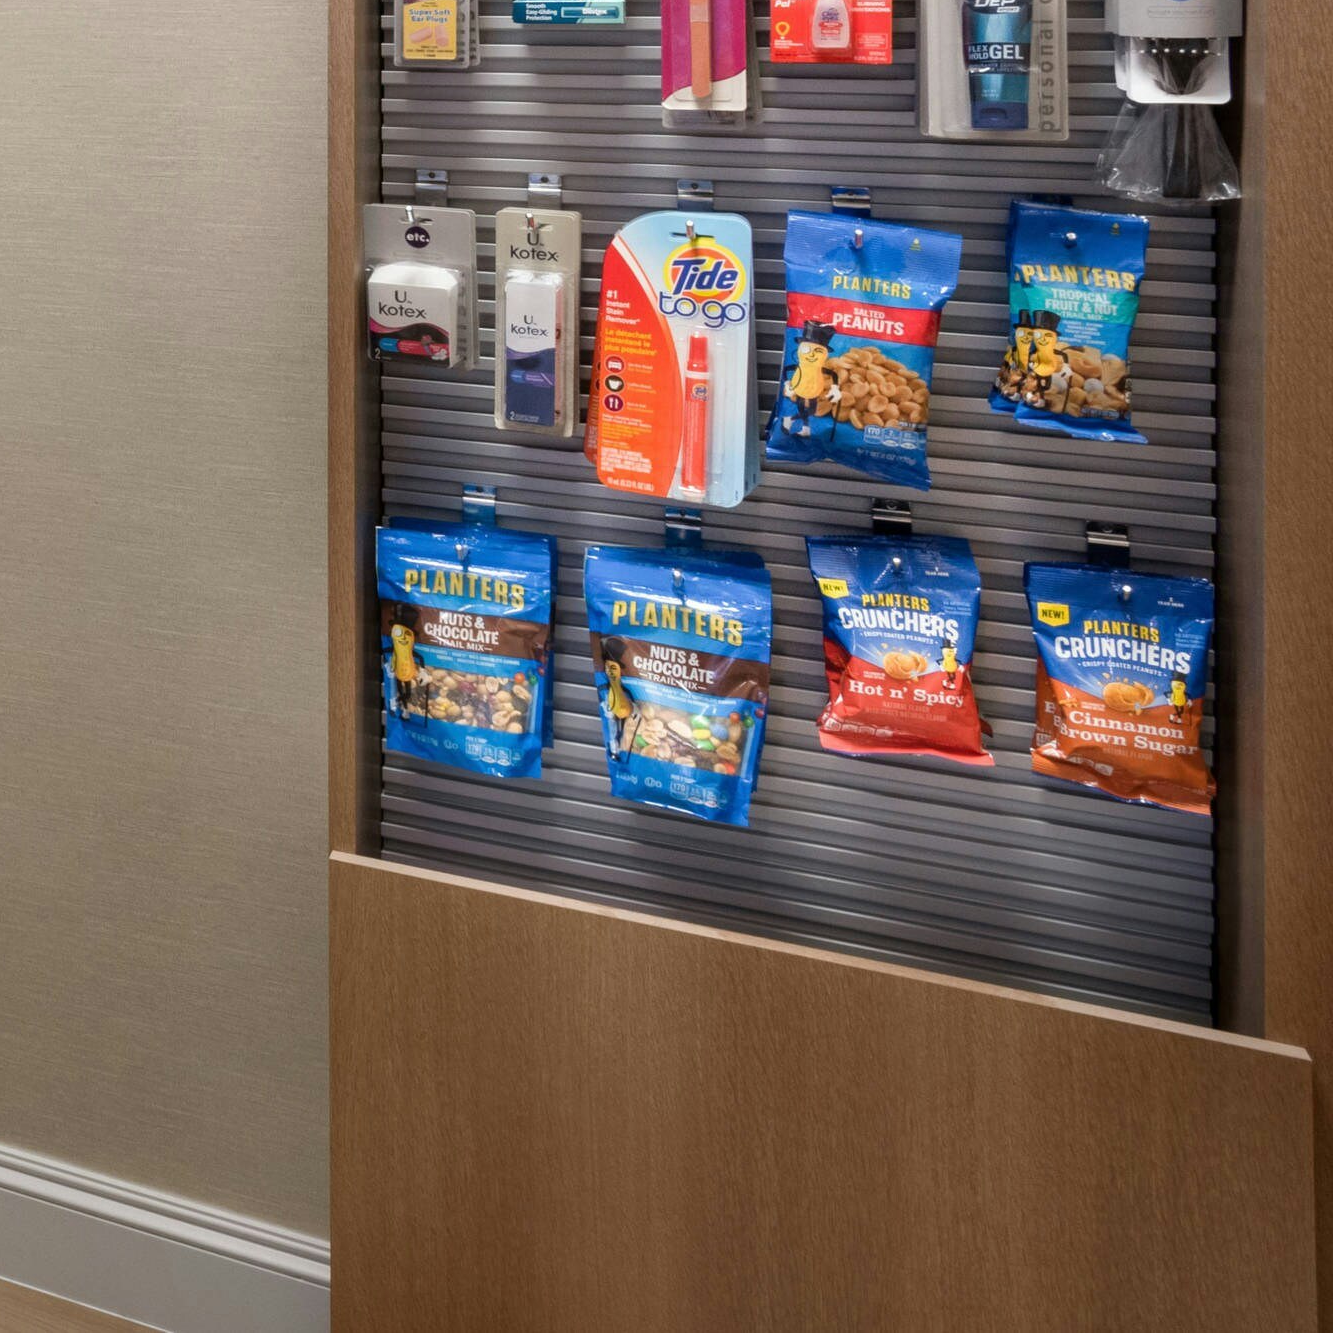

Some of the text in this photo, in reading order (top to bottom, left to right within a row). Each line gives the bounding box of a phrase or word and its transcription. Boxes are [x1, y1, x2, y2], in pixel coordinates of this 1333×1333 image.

[434, 8, 450, 16] Soft
[775, 0, 790, 8] Pal
[989, 44, 1024, 60] GEL
[510, 244, 557, 262] kotex
[673, 259, 739, 295] Tide
[1024, 265, 1136, 292] PLANTERS
[606, 290, 617, 299] #1
[833, 276, 911, 300] PLANTERS
[1051, 288, 1108, 304] TROPICAL
[379, 303, 425, 319] kotex
[606, 300, 630, 309] Instant
[659, 291, 746, 328] to go
[853, 308, 885, 318] SALTED
[1045, 298, 1118, 316] FRUIT NUT
[510, 324, 549, 337] kotex
[833, 314, 905, 336] PEANUTS
[405, 569, 525, 611] PLANTERS
[822, 581, 845, 593] NEW!
[439, 611, 473, 628] NUTS
[612, 600, 744, 647] PLANTERS
[1041, 608, 1065, 621] NEW!
[424, 621, 499, 646] CHOCOLATE
[839, 607, 959, 642] CRUNCHERS
[466, 642, 484, 651] MIX
[649, 645, 688, 665] NUTS
[1054, 635, 1191, 675] CRUNCHERS
[633, 654, 714, 685] CHOCOLATE
[648, 673, 699, 691] TRAIL MIX
[848, 679, 965, 709] Hot Spicy
[1069, 710, 1185, 740] Cinnamon
[1134, 736, 1198, 757] Sugar
